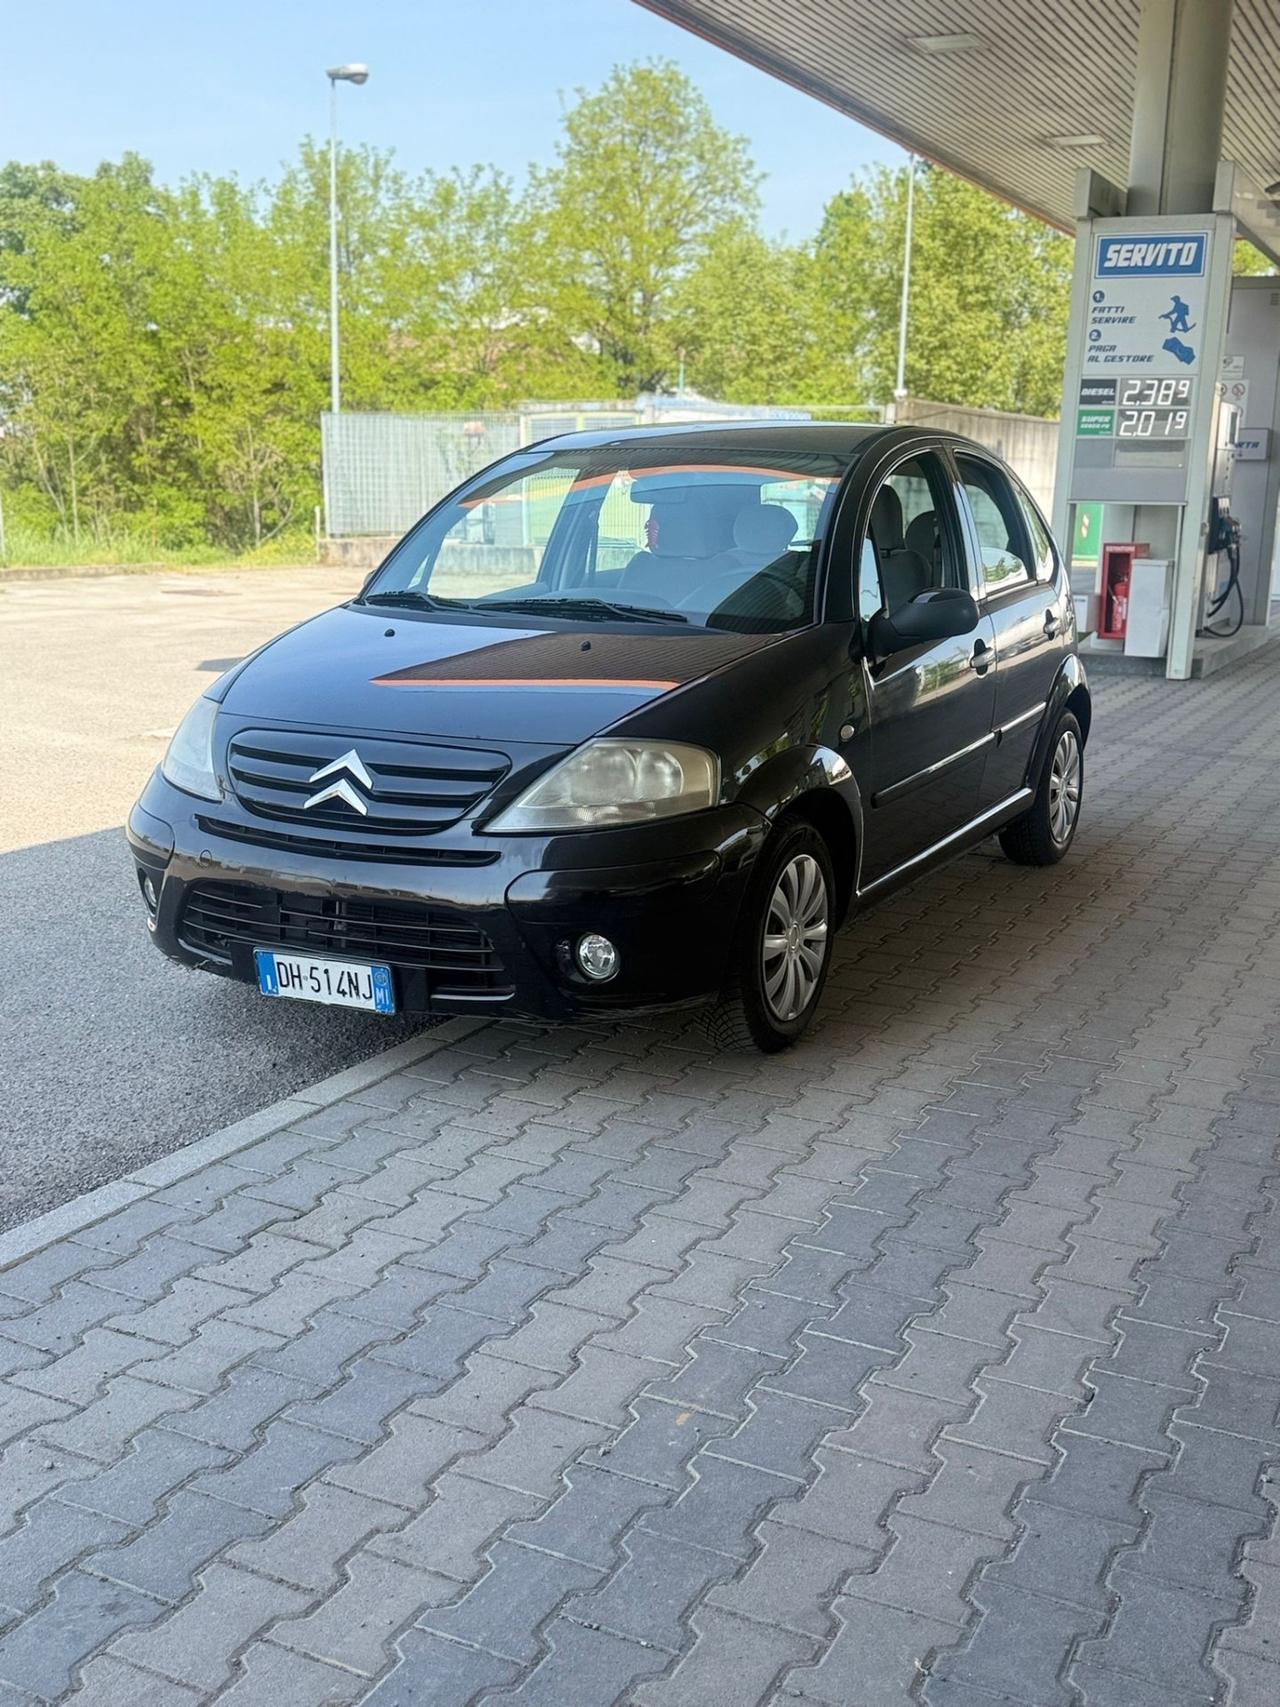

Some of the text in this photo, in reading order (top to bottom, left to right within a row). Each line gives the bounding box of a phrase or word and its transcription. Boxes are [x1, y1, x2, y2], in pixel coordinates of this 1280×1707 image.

[1104, 242, 1198, 267] SERVITO
[1091, 316, 1137, 324] SERVIRE
[266, 974, 273, 990] I
[375, 987, 390, 1005] MI
